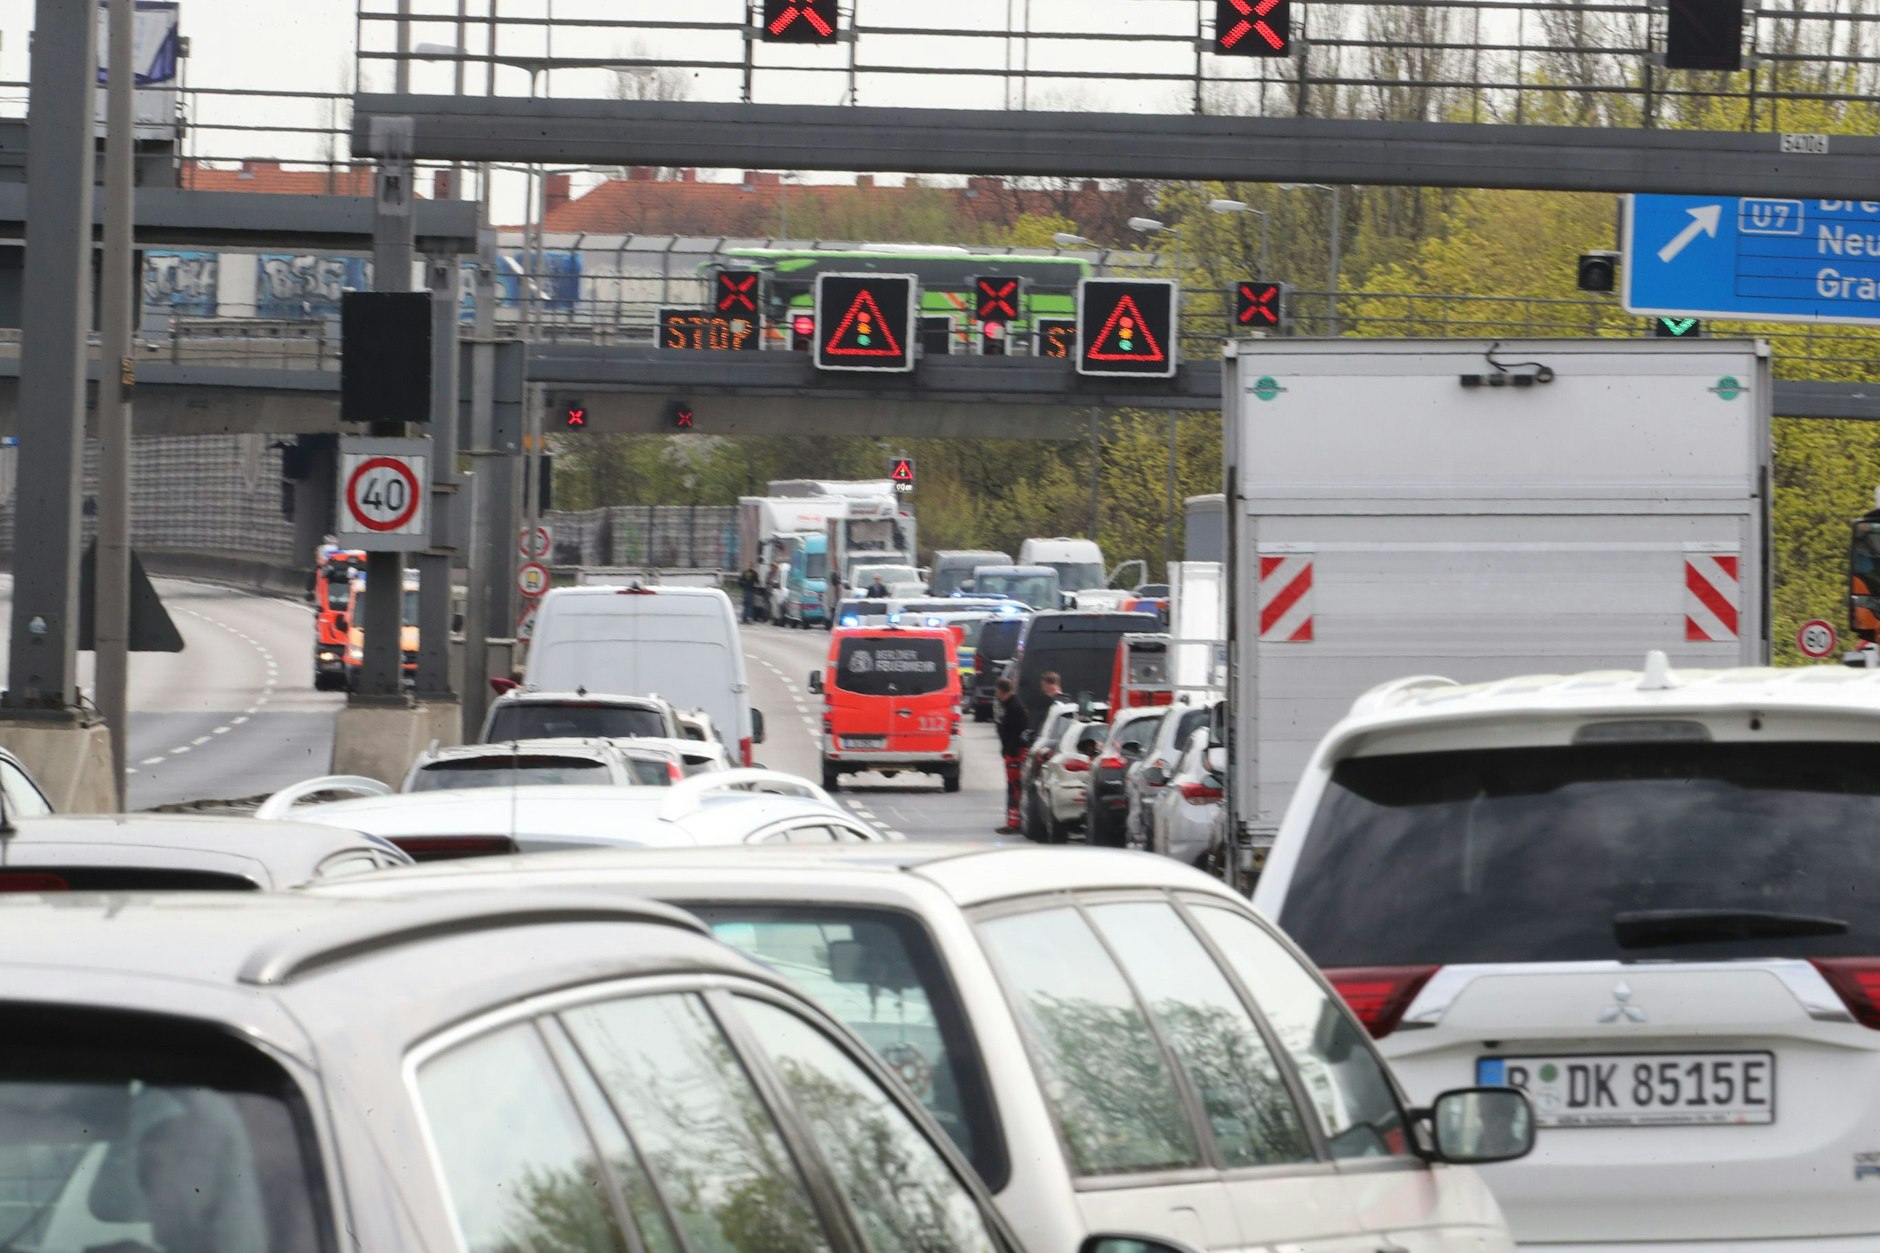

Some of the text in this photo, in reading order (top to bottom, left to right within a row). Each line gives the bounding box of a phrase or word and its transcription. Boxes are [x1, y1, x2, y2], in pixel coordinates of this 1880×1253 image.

[1751, 204, 1790, 228] U7
[1816, 267, 1880, 300] Gra
[667, 316, 753, 351] STOP
[1046, 326, 1079, 359] S
[362, 478, 404, 511] 40
[917, 716, 947, 732] 112
[1567, 1063, 1618, 1107] DK
[1632, 1061, 1766, 1106] 8515E
